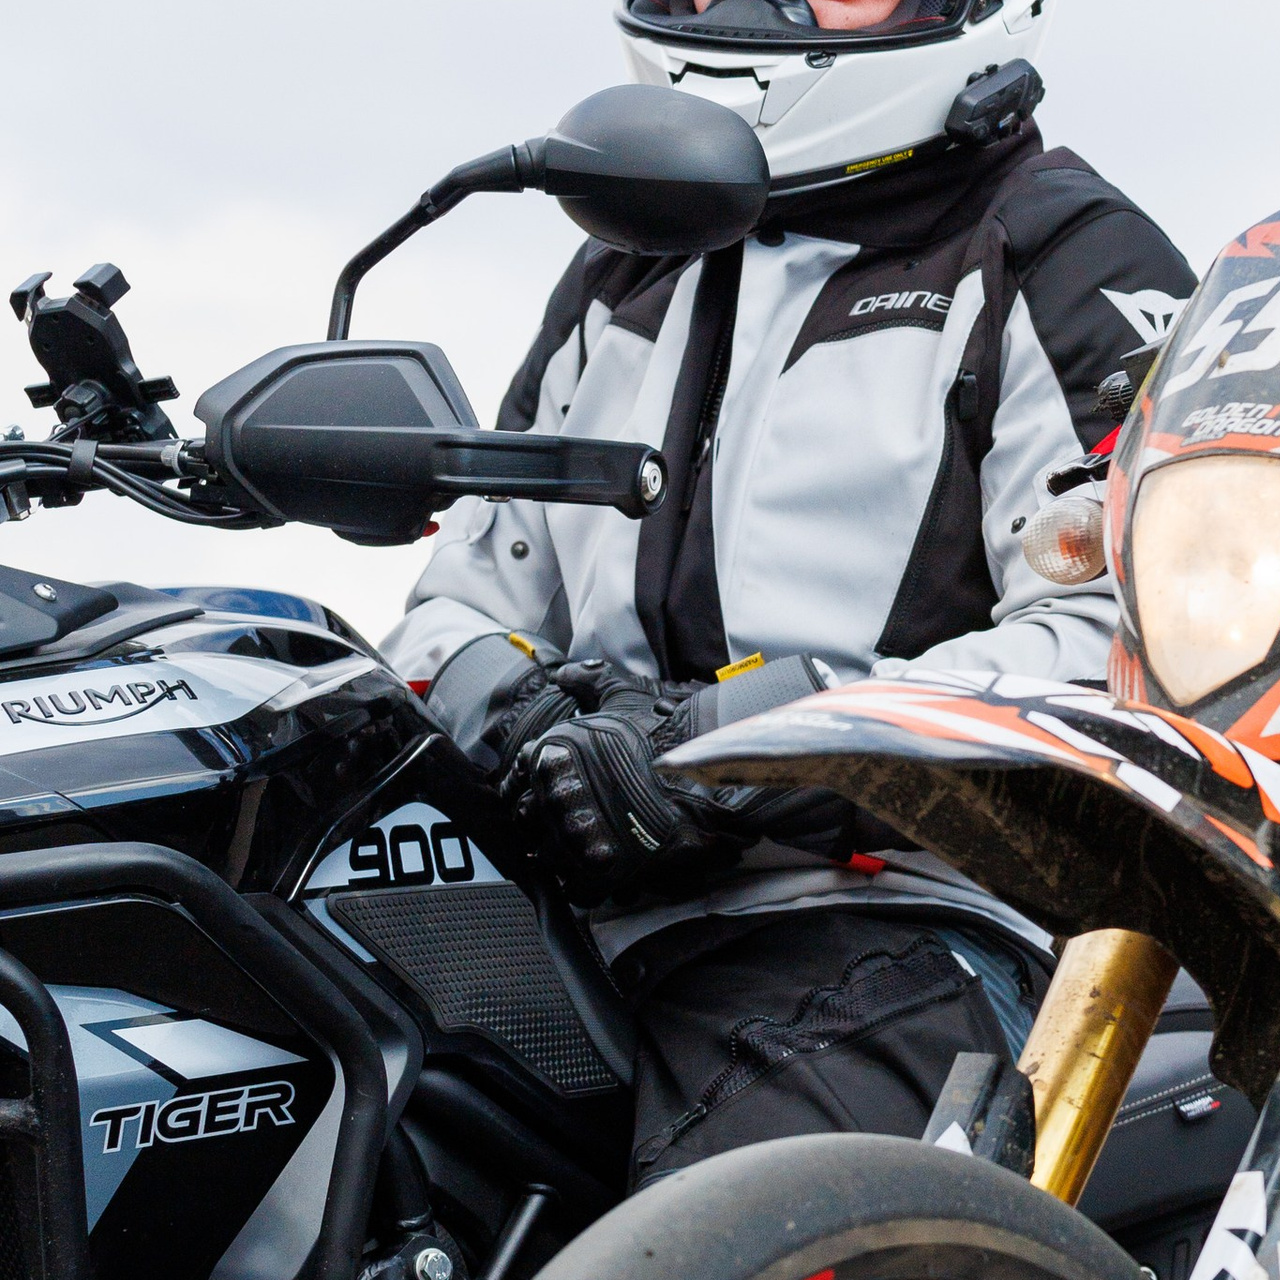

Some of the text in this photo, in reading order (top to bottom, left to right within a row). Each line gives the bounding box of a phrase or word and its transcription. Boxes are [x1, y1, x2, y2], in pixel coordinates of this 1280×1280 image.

[848, 290, 954, 316] DAINE
[1181, 402, 1273, 428] GOLDEN
[1, 679, 198, 726] RIUMPH
[348, 821, 475, 886] 900
[89, 1080, 297, 1154] TIGER
